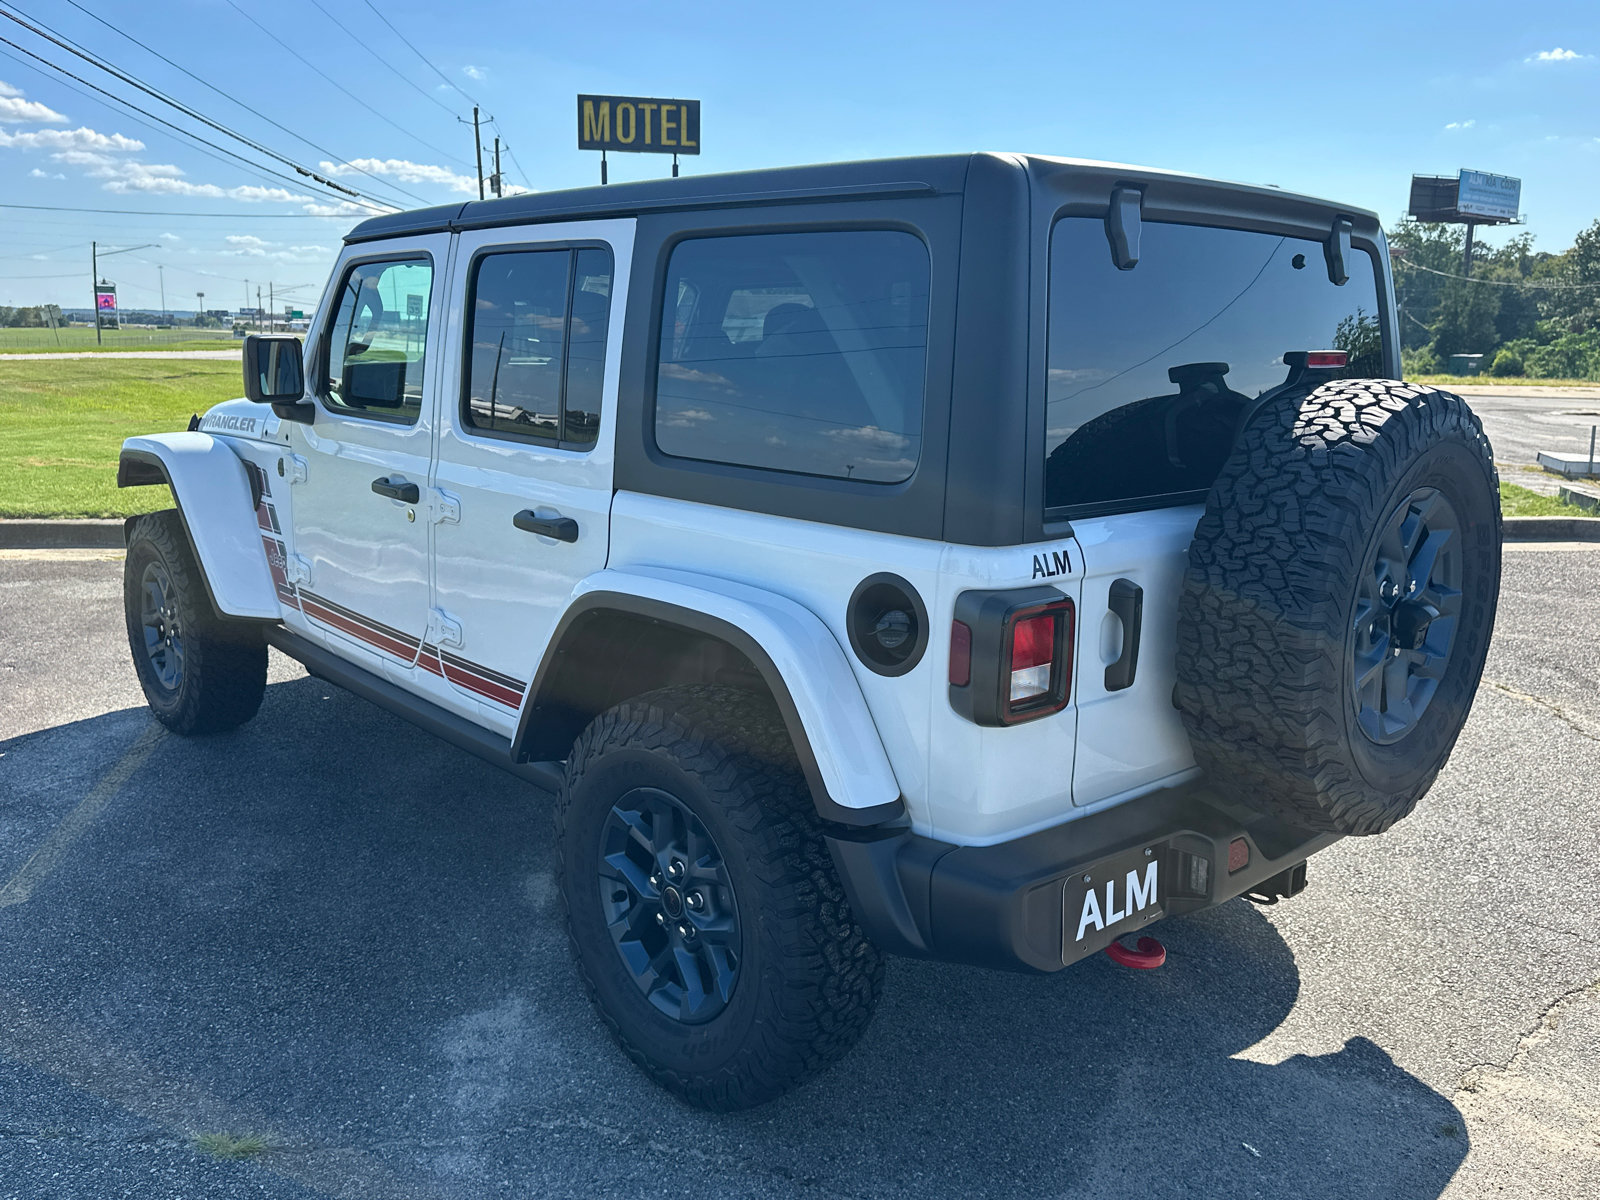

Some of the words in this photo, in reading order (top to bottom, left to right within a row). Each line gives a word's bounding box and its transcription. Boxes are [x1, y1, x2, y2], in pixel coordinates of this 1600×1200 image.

[583, 100, 697, 147] MOTEL
[202, 414, 257, 433] WRANGLER
[269, 547, 286, 569] Jeep
[1032, 549, 1072, 579] ALM
[1075, 859, 1159, 942] ALM
